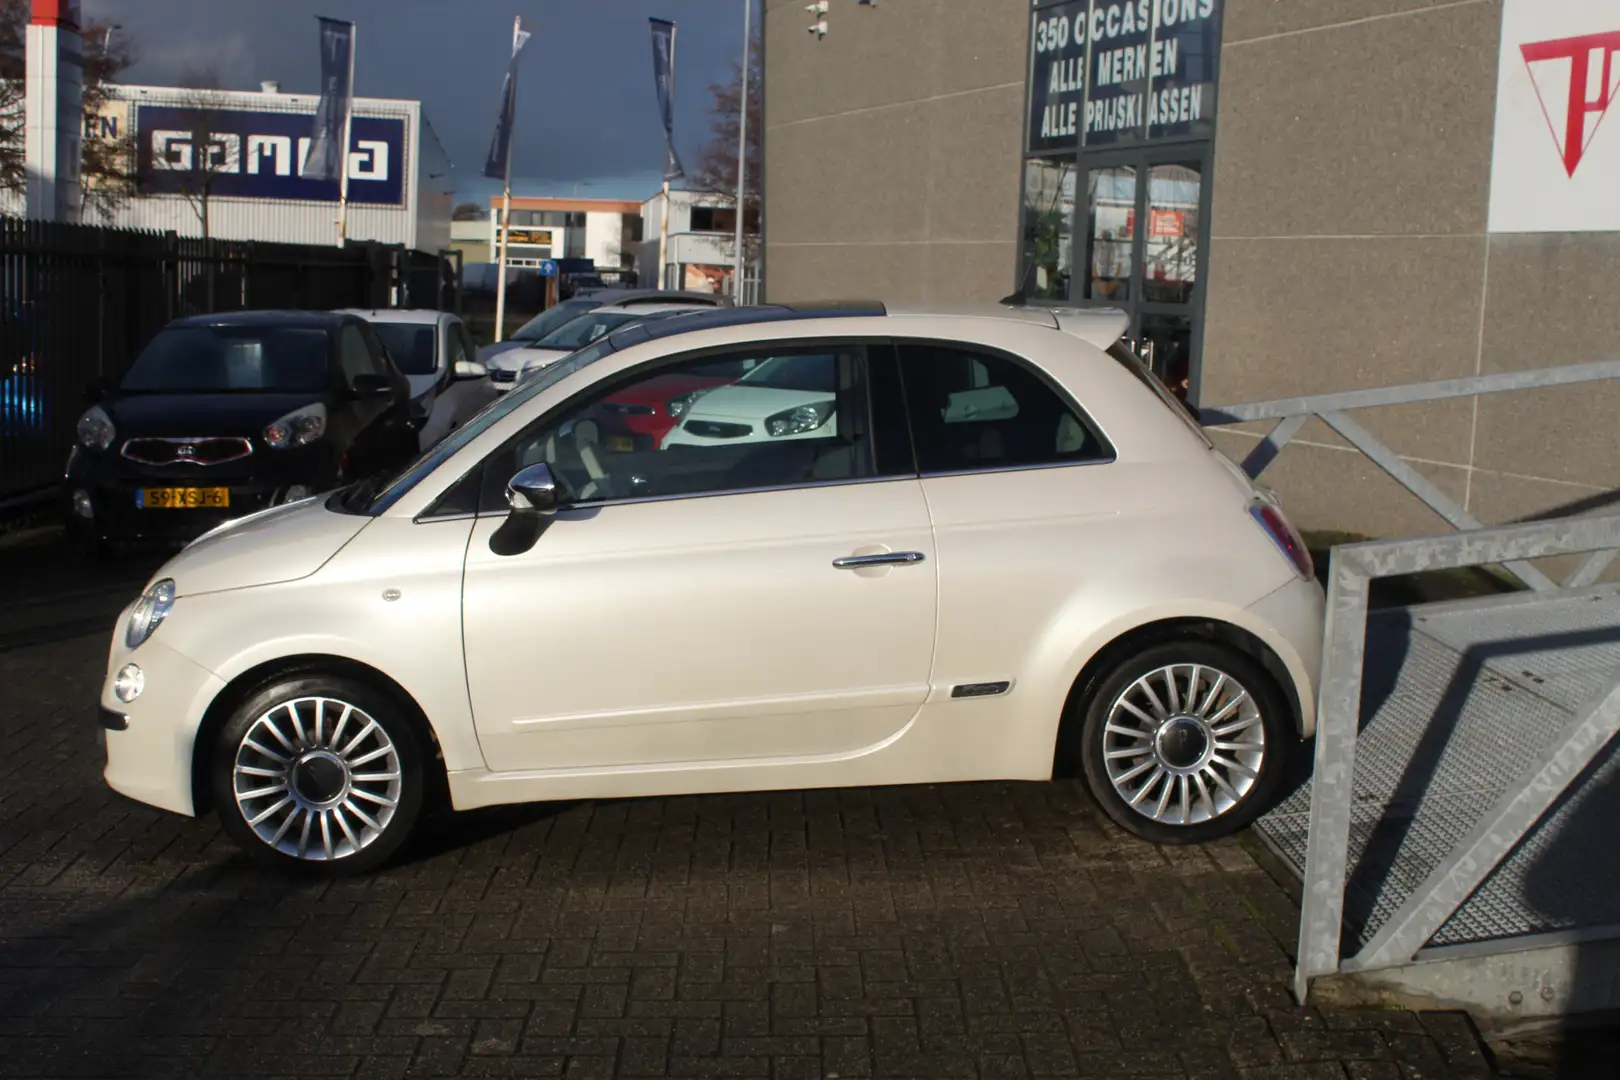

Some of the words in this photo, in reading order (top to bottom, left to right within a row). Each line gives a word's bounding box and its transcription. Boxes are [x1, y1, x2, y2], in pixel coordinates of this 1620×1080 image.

[1036, 16, 1069, 53] 350
[1097, 37, 1179, 86] MERKEN
[1041, 101, 1077, 139] ALLE
[150, 490, 222, 505] 59-XSJ-6
